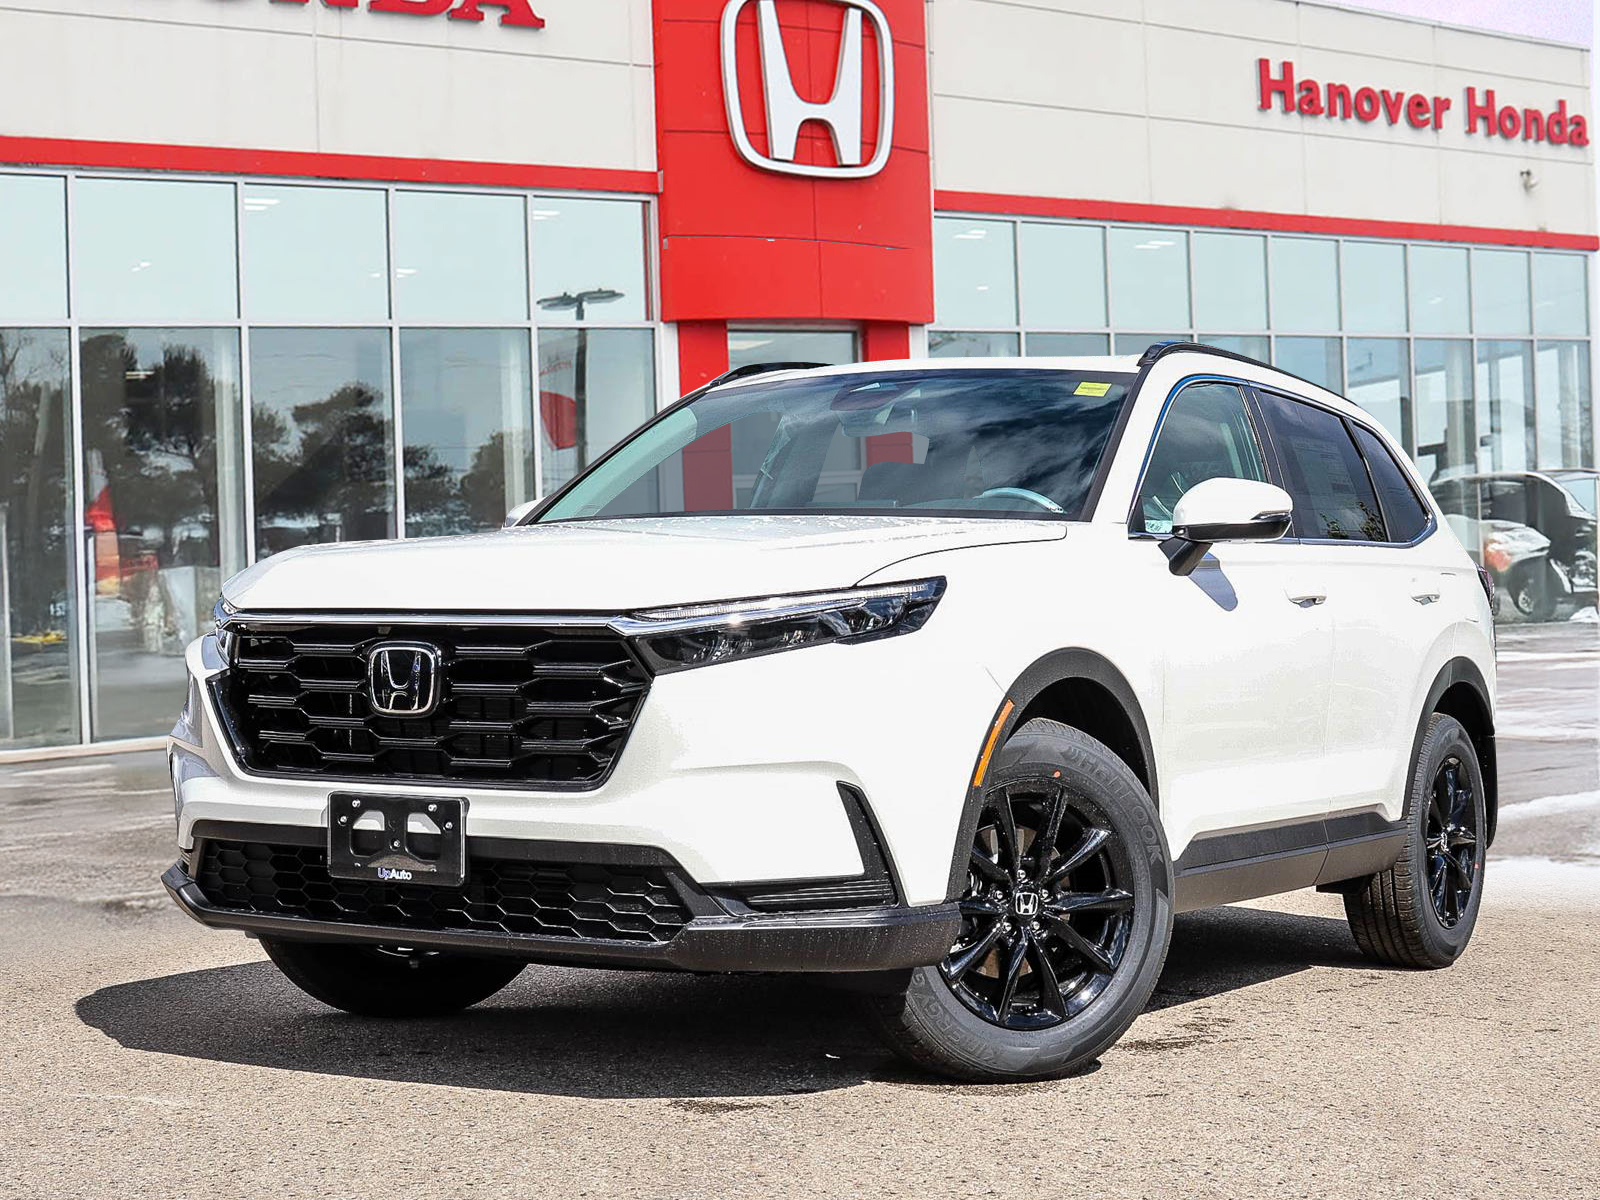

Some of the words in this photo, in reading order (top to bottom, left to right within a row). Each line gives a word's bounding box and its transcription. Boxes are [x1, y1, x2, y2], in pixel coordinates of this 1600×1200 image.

[1257, 58, 1452, 130] Hanover
[1465, 86, 1590, 147] Honda
[377, 867, 413, 881] UpAuto
